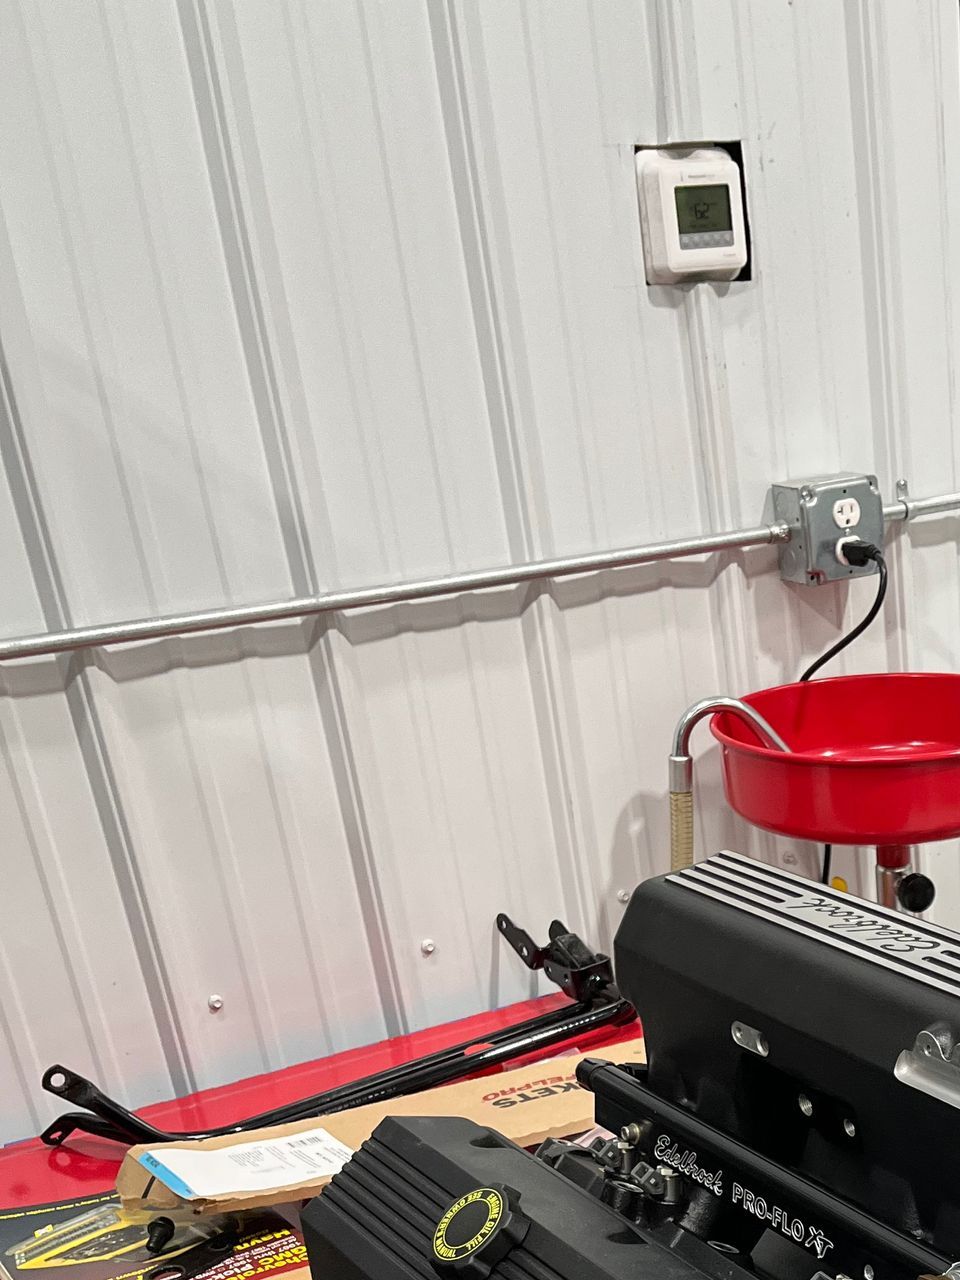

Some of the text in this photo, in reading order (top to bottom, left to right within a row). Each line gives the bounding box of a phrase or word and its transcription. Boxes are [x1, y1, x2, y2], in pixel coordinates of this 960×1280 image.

[654, 1134, 723, 1196] Edelbrock
[732, 1182, 804, 1242] PRO-FLO
[435, 1191, 483, 1258] SEE OWNER'S MANUAL
[465, 1193, 500, 1250] ENGINE OIL FILL
[259, 1245, 307, 1266] GMC
